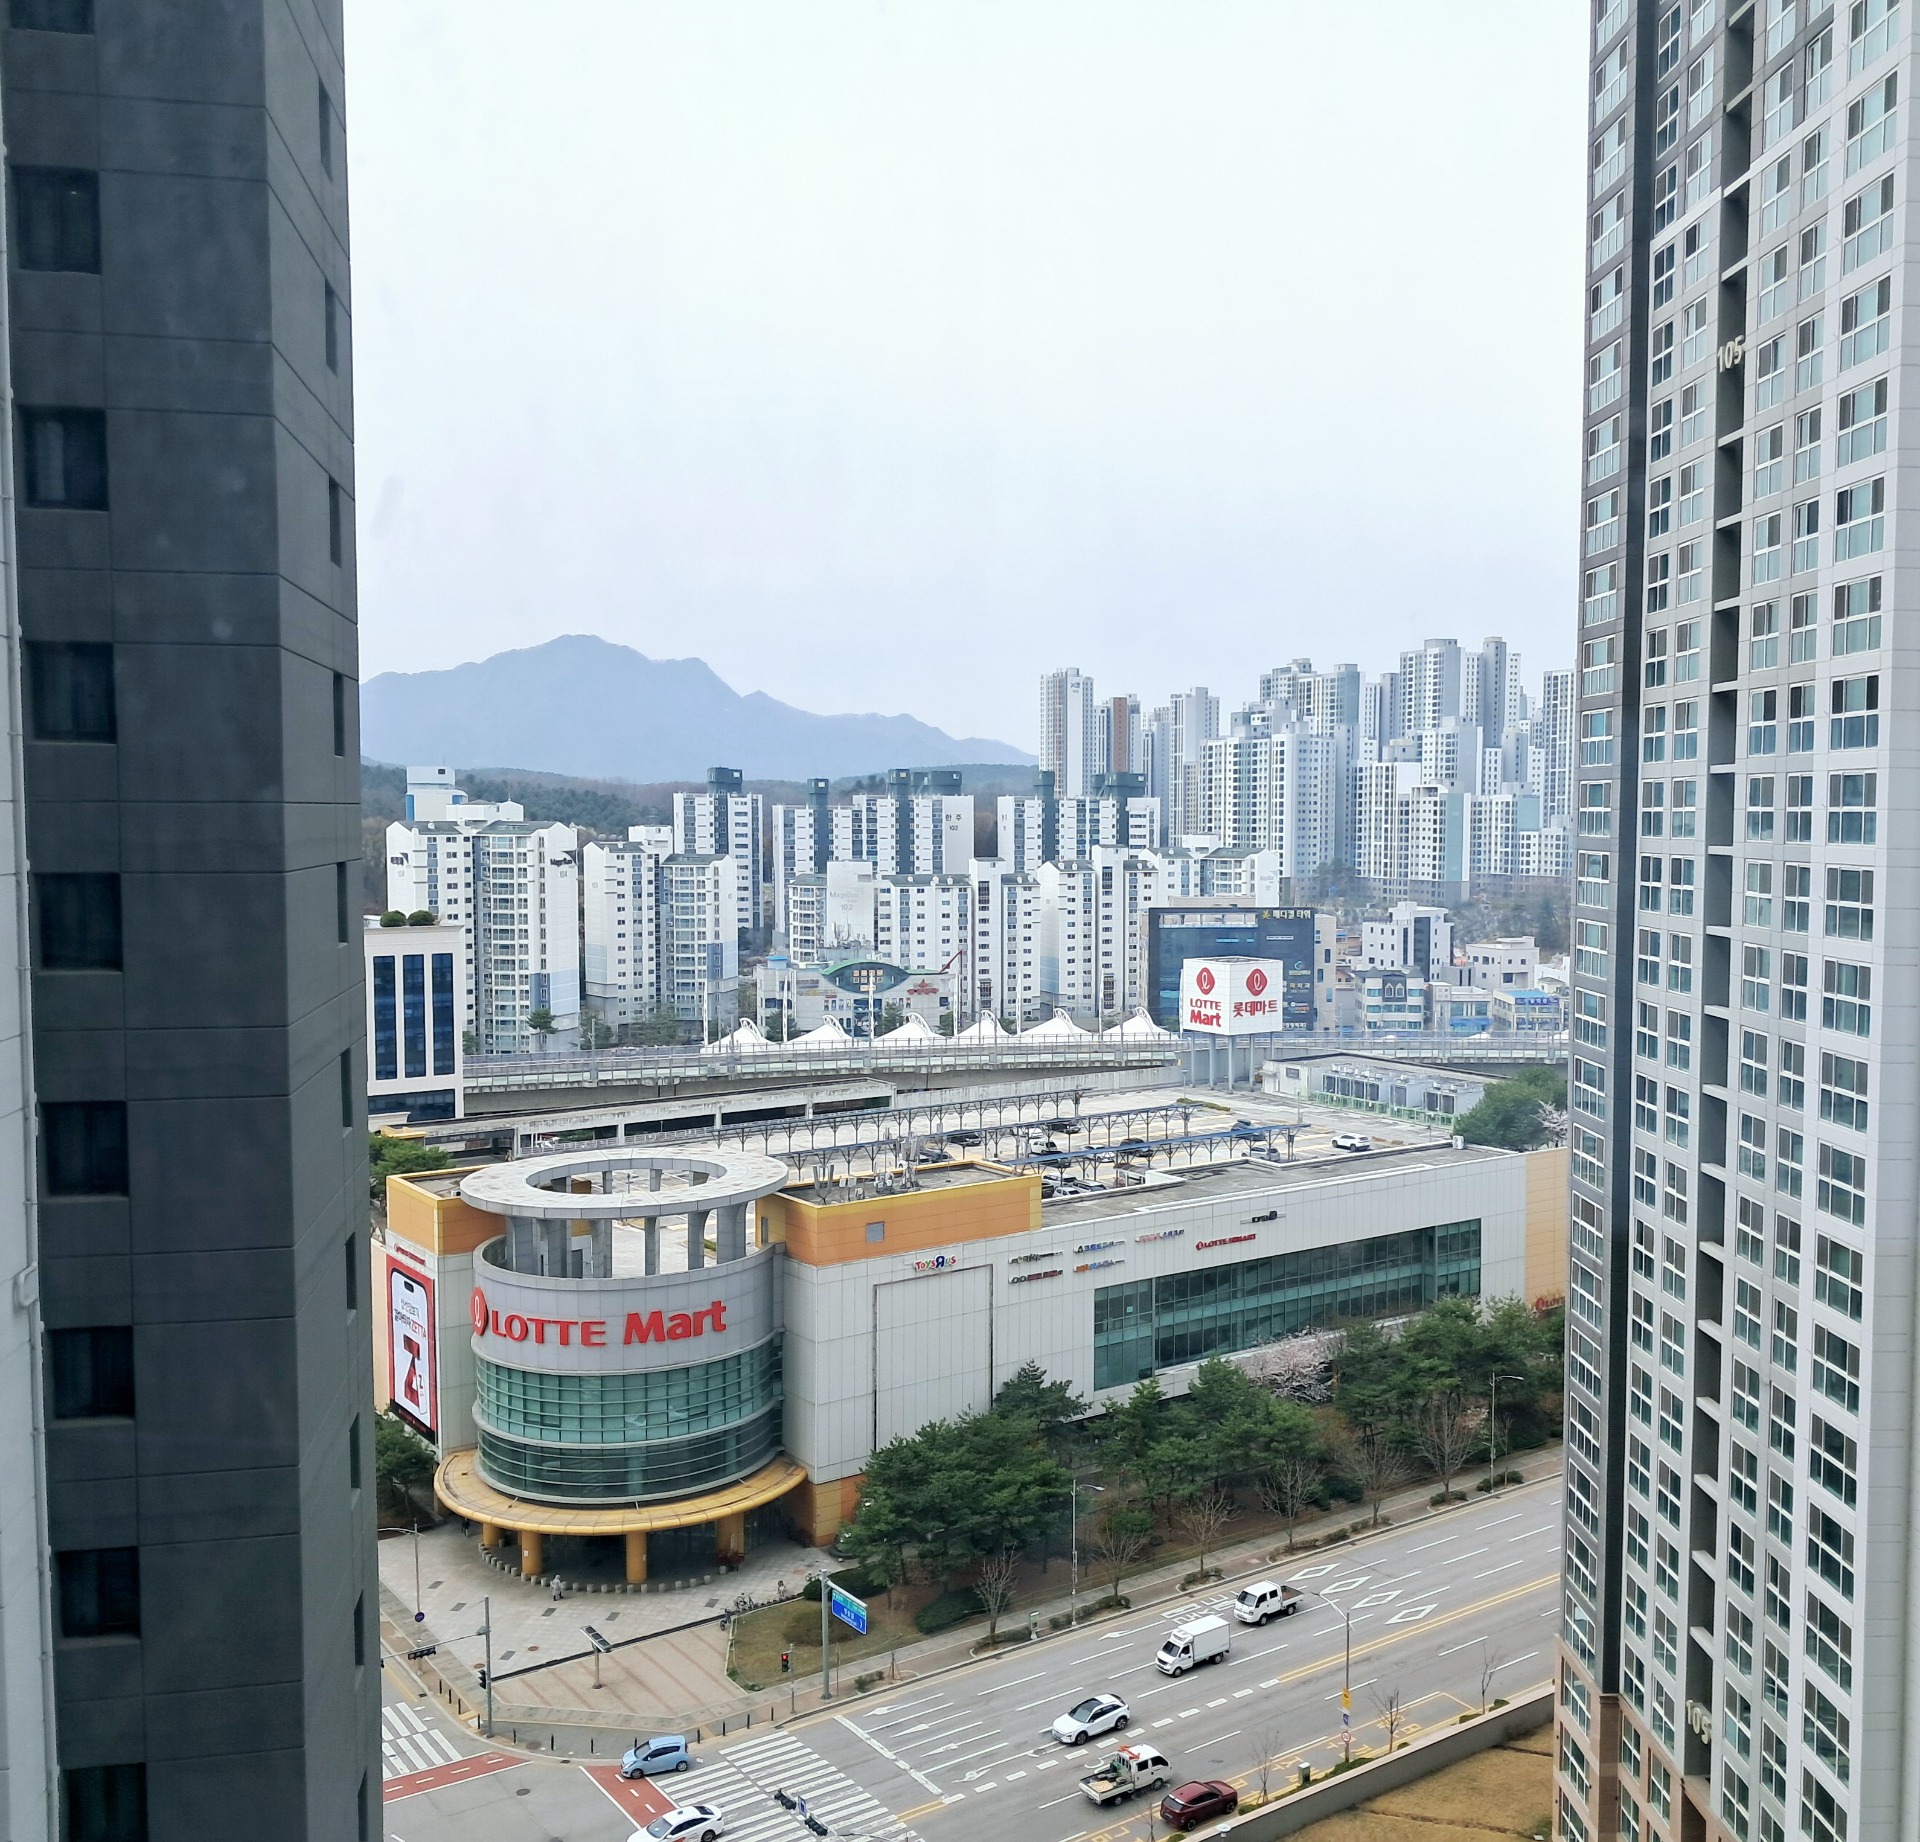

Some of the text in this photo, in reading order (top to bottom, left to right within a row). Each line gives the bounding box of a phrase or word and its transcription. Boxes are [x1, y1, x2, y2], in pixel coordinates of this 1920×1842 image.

[1717, 334, 1744, 373] 105
[1190, 998, 1221, 1011] LOTTE
[1190, 1009, 1222, 1027] Mart
[1232, 999, 1278, 1018] 롯데마트
[491, 1300, 727, 1346] LOTTE Mart
[1686, 1699, 1711, 1744] 105
